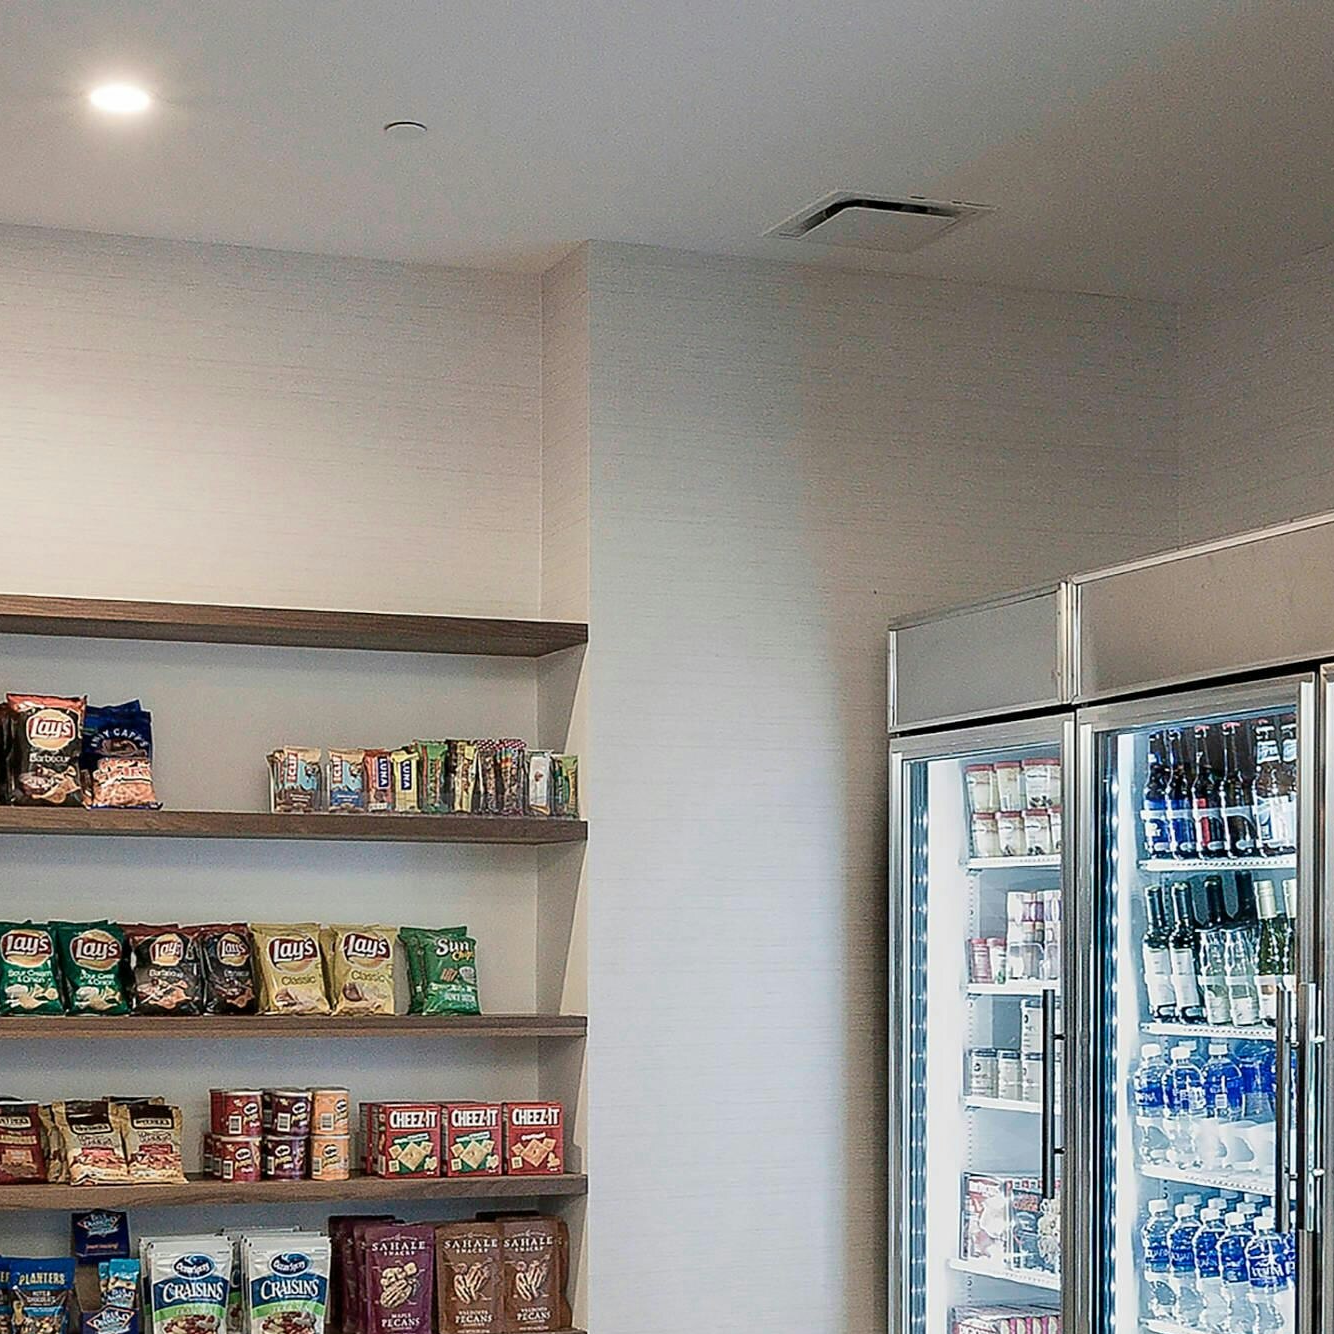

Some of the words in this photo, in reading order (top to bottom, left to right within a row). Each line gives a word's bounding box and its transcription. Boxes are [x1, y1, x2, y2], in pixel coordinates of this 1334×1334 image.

[31, 717, 72, 738] Lay's
[379, 757, 389, 787] LUNA
[401, 760, 411, 788] LUNA
[7, 935, 49, 956] Lay's
[76, 939, 118, 959] Lay's
[273, 936, 315, 962] Lay's
[347, 933, 388, 959] Lay's
[436, 938, 470, 958] Sun
[282, 975, 316, 986] Classic
[351, 970, 386, 982] Classic
[372, 1241, 426, 1251] SAHALE
[445, 1239, 498, 1248] SAHALE
[503, 1237, 553, 1247] SAHALE
[19, 1272, 65, 1285] PLANTERS
[163, 1282, 224, 1302] CRAISINS
[261, 1279, 319, 1300] CRAISINS
[381, 1318, 420, 1328] PECANS
[455, 1314, 492, 1324] PECANS
[516, 1311, 551, 1321] PECANS
